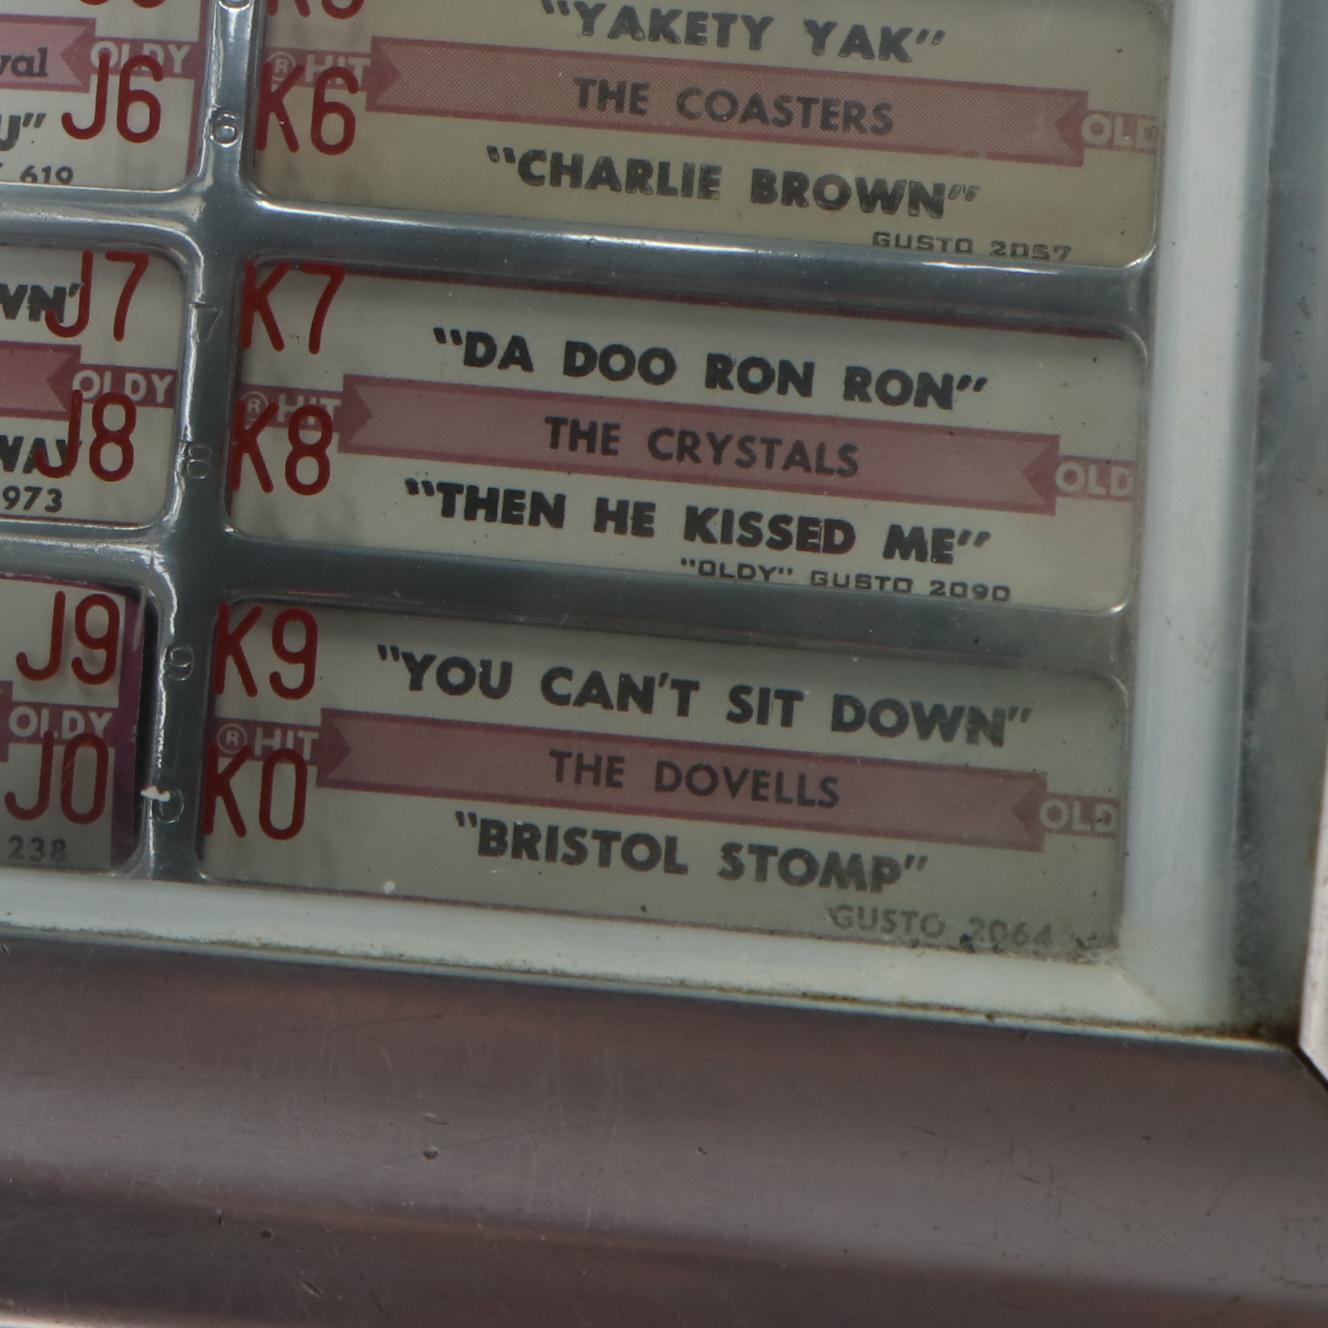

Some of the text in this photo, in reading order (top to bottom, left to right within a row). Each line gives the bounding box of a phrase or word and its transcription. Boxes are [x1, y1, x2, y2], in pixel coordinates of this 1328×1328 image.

[803, 19, 945, 64] YAK"
[62, 52, 164, 144] J6
[255, 64, 358, 156] K6
[574, 76, 894, 136] THE COASTERS
[486, 144, 978, 219] "CHARLIE BROWN"
[871, 230, 1072, 262] GUSTO 2057
[45, 250, 152, 342] J7
[432, 326, 988, 410] "DA DOO RON RON"
[230, 400, 334, 495] K8
[544, 414, 860, 476] THE CRYSTALS
[807, 568, 915, 593] GUSTO
[927, 578, 1012, 602] 2090
[16, 590, 118, 685] J9
[212, 603, 318, 700] K9
[376, 643, 1032, 747] "YOU CAN'T SIT DOWN"
[548, 749, 840, 809] THE DOVELLS
[454, 810, 928, 892] "BRISTOL STOMP"
